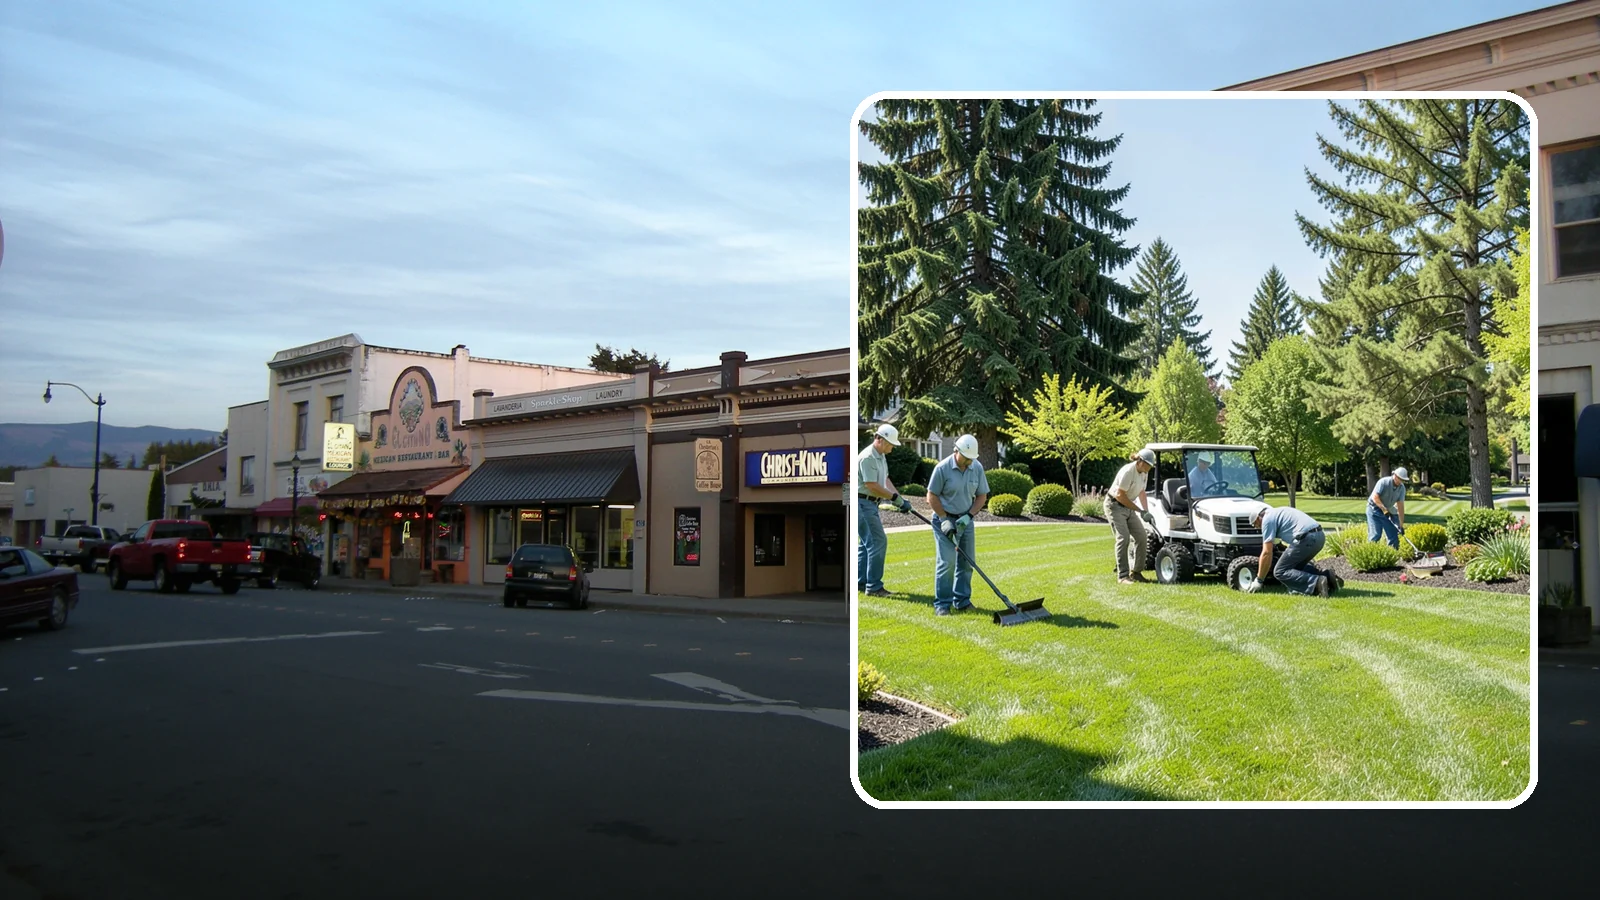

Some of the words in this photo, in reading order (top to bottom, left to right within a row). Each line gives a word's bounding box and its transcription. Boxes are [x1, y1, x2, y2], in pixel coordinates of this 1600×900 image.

[595, 389, 624, 400] LAUNDRY
[493, 402, 523, 413] LAVANDERIA
[374, 455, 396, 464] MEXICAN
[397, 451, 433, 462] RESTAURANT
[437, 450, 450, 459] BAR
[760, 452, 797, 478] CHRIST
[799, 450, 827, 476] KING
